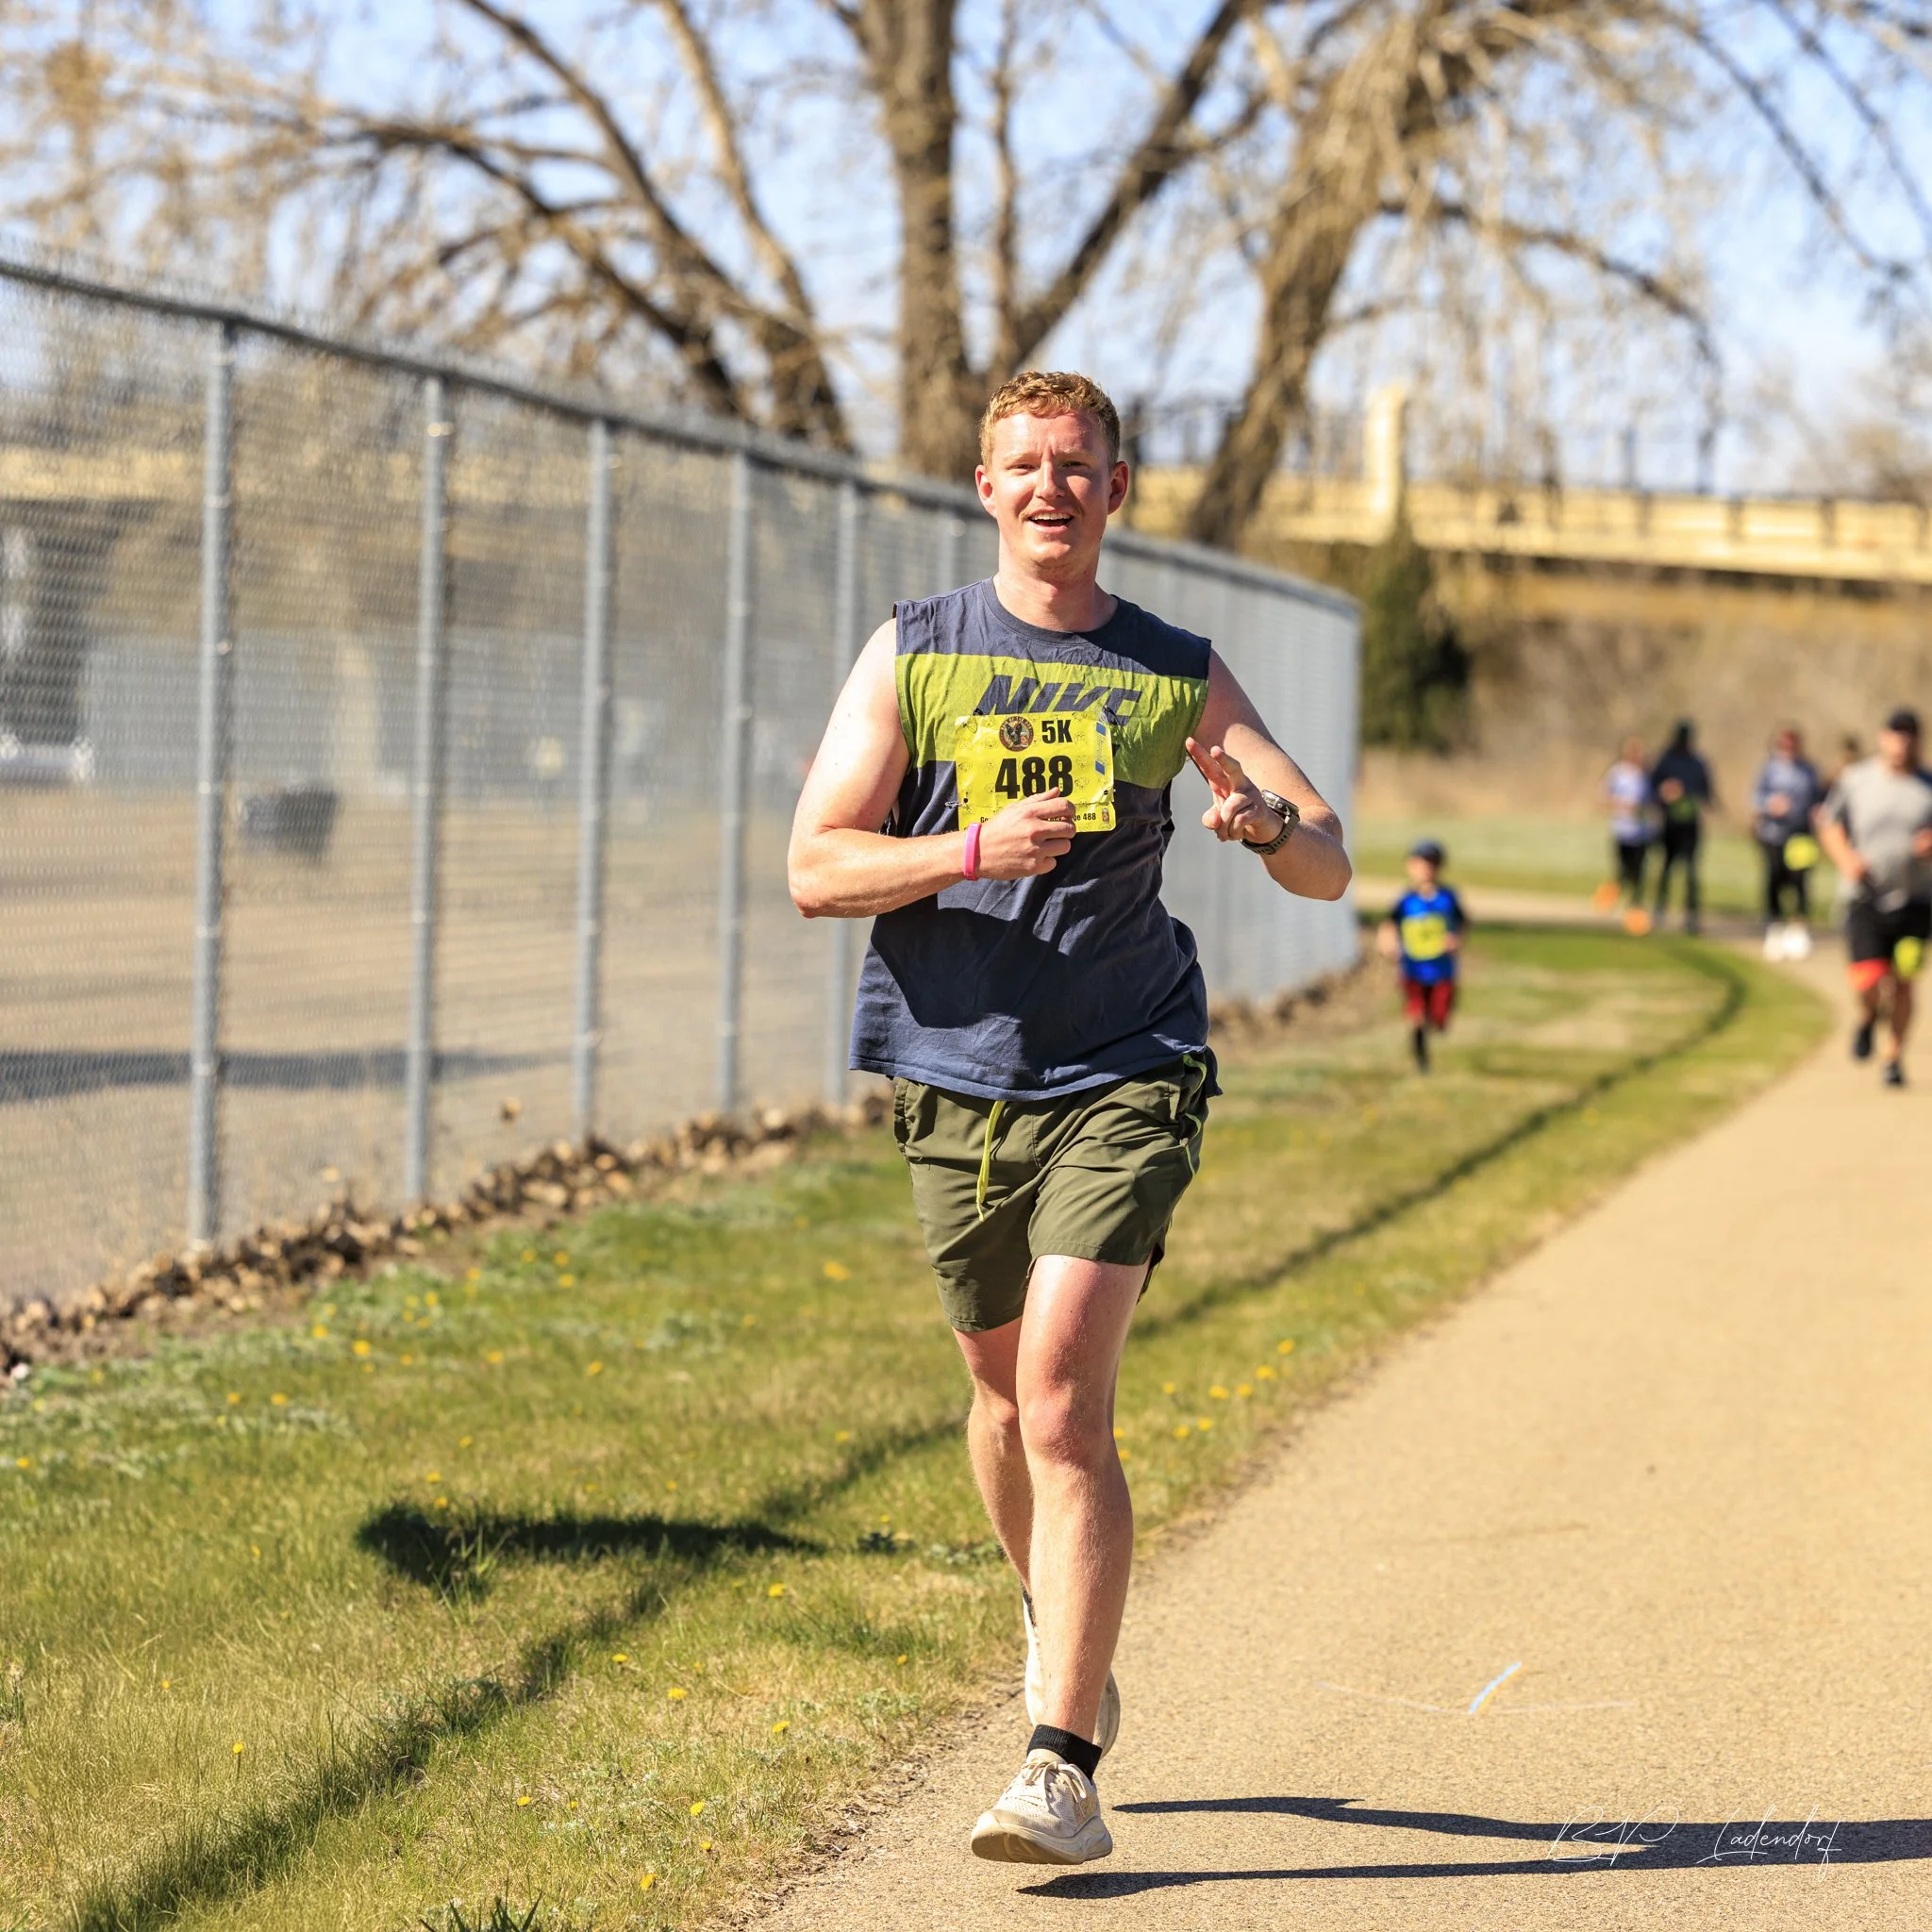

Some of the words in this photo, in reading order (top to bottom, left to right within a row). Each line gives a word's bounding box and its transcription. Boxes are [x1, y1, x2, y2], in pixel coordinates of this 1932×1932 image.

[1041, 720, 1073, 743] 5K
[994, 756, 1074, 799] 488
[1082, 812, 1096, 821] 488
